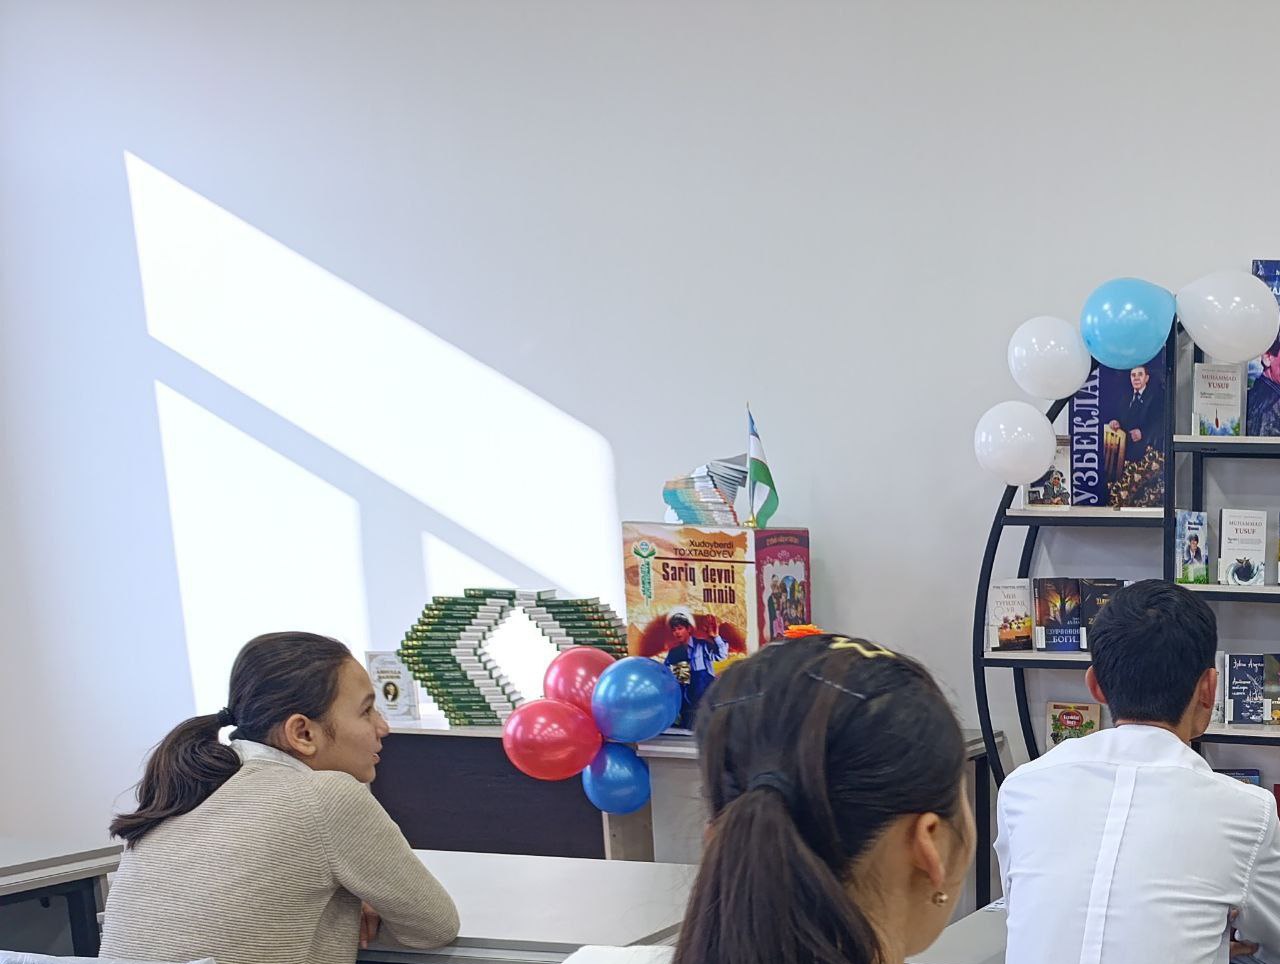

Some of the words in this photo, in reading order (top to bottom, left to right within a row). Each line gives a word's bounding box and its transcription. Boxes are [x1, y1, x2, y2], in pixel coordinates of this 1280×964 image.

[1073, 367, 1100, 504] УЗБЕКЛА
[689, 539, 734, 549] Xudoyberdi
[662, 562, 696, 586] Sariq
[702, 564, 735, 584] devni
[702, 585, 736, 604] minib
